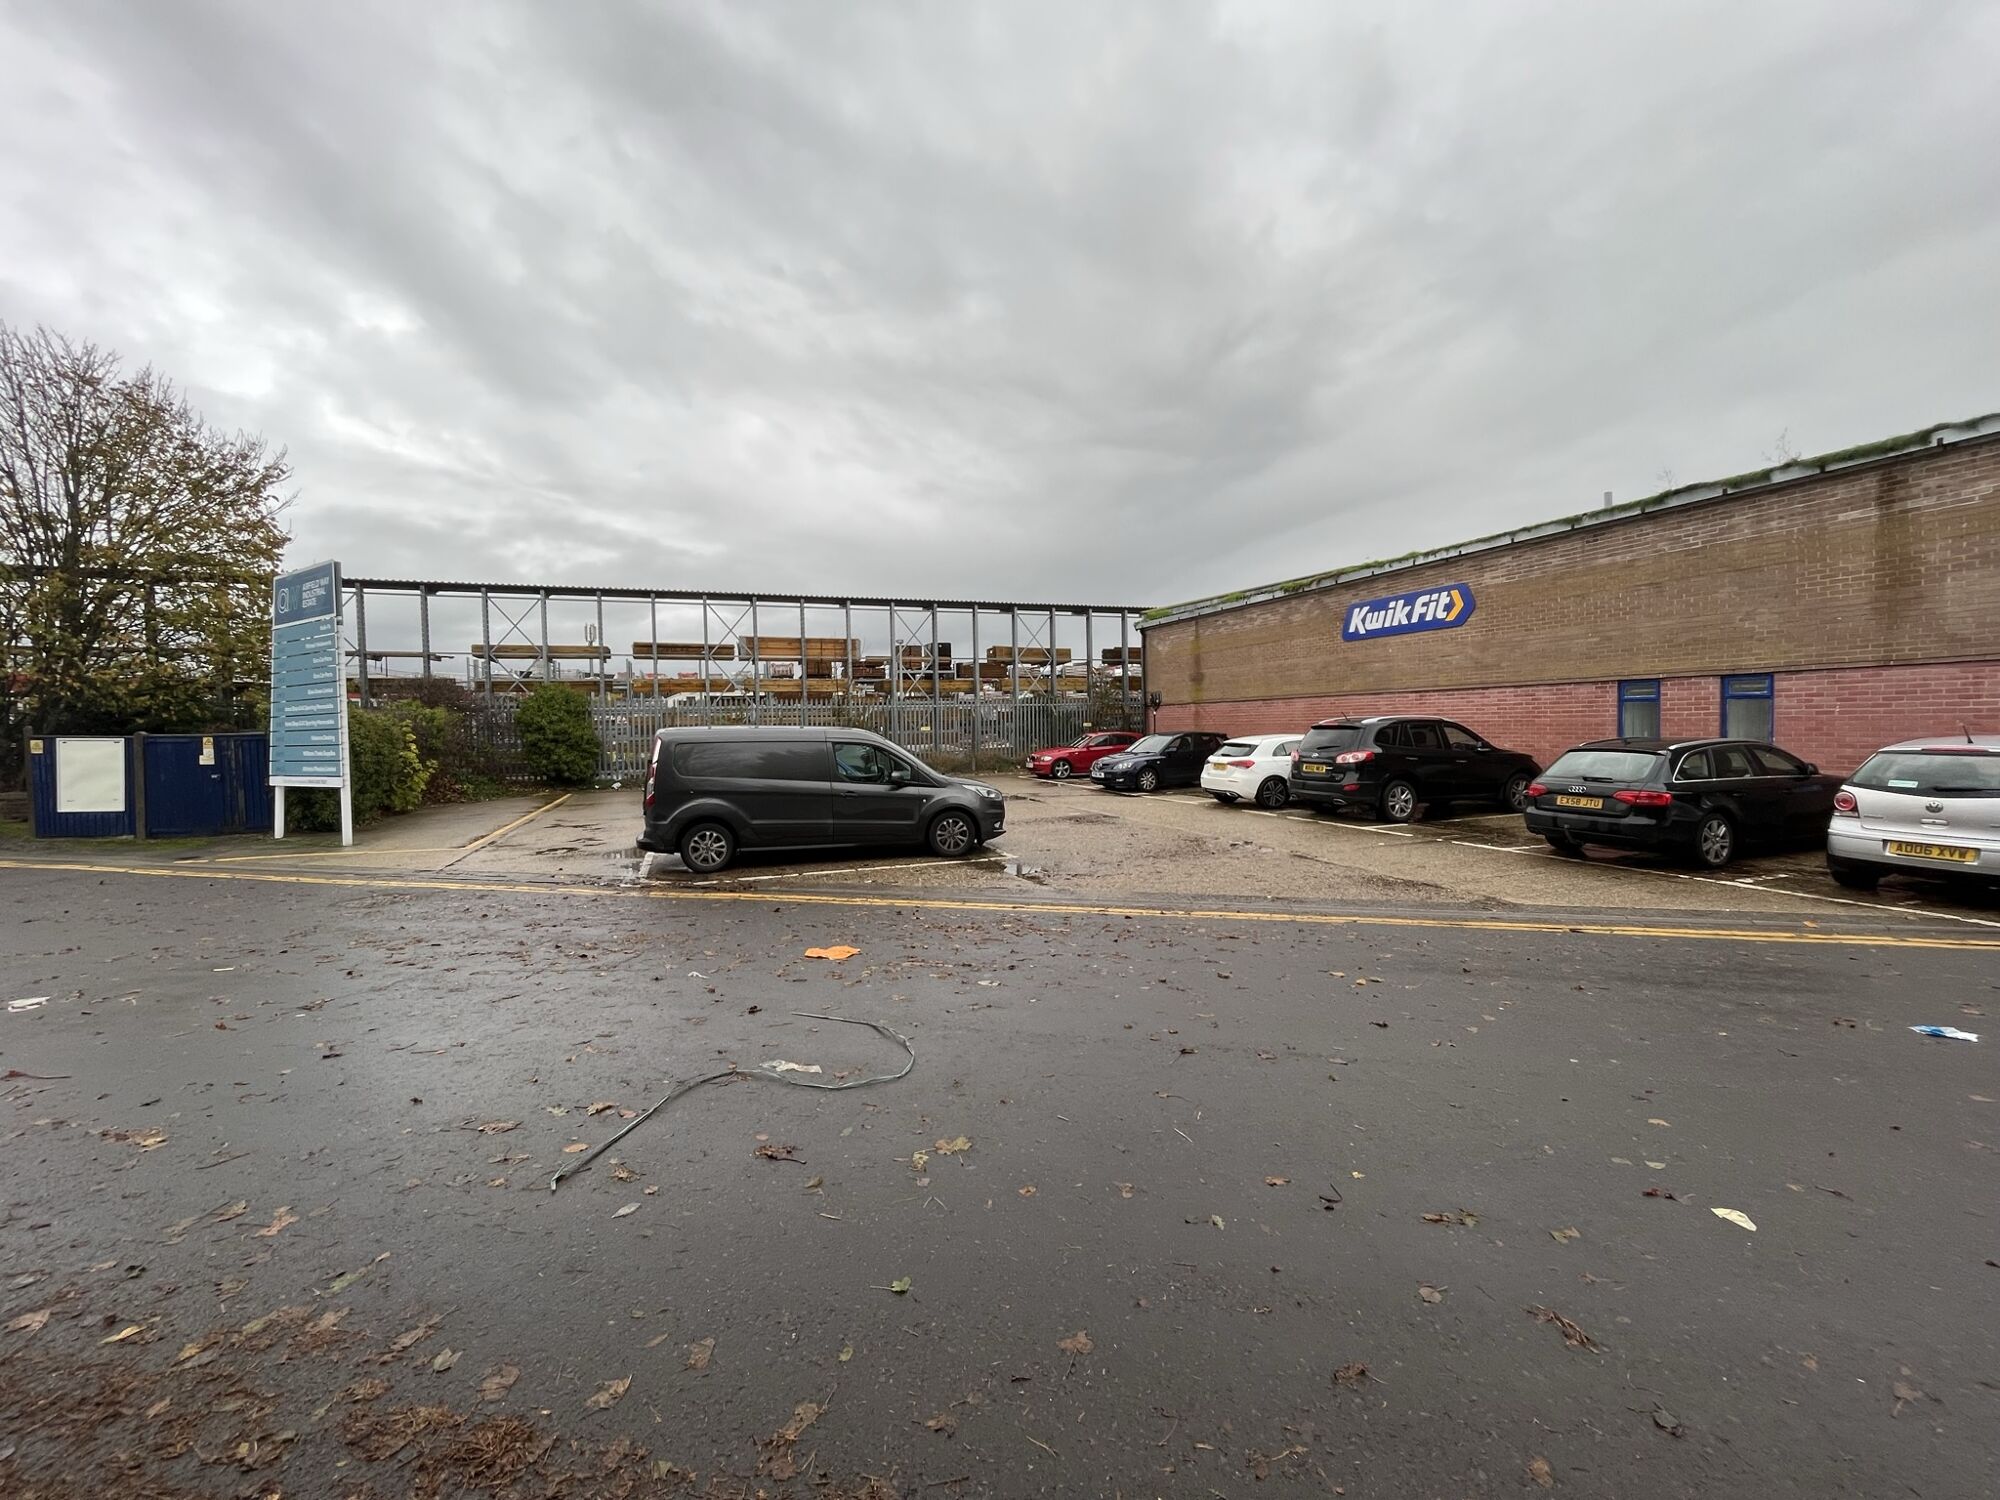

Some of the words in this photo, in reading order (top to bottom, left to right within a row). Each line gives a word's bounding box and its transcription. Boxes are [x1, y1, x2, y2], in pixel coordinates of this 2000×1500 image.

[1348, 599, 1412, 634] Kwik
[1410, 591, 1451, 623] Fit
[1560, 796, 1582, 806] EX58
[1582, 799, 1600, 808] JTU
[1936, 847, 1968, 859] XVW
